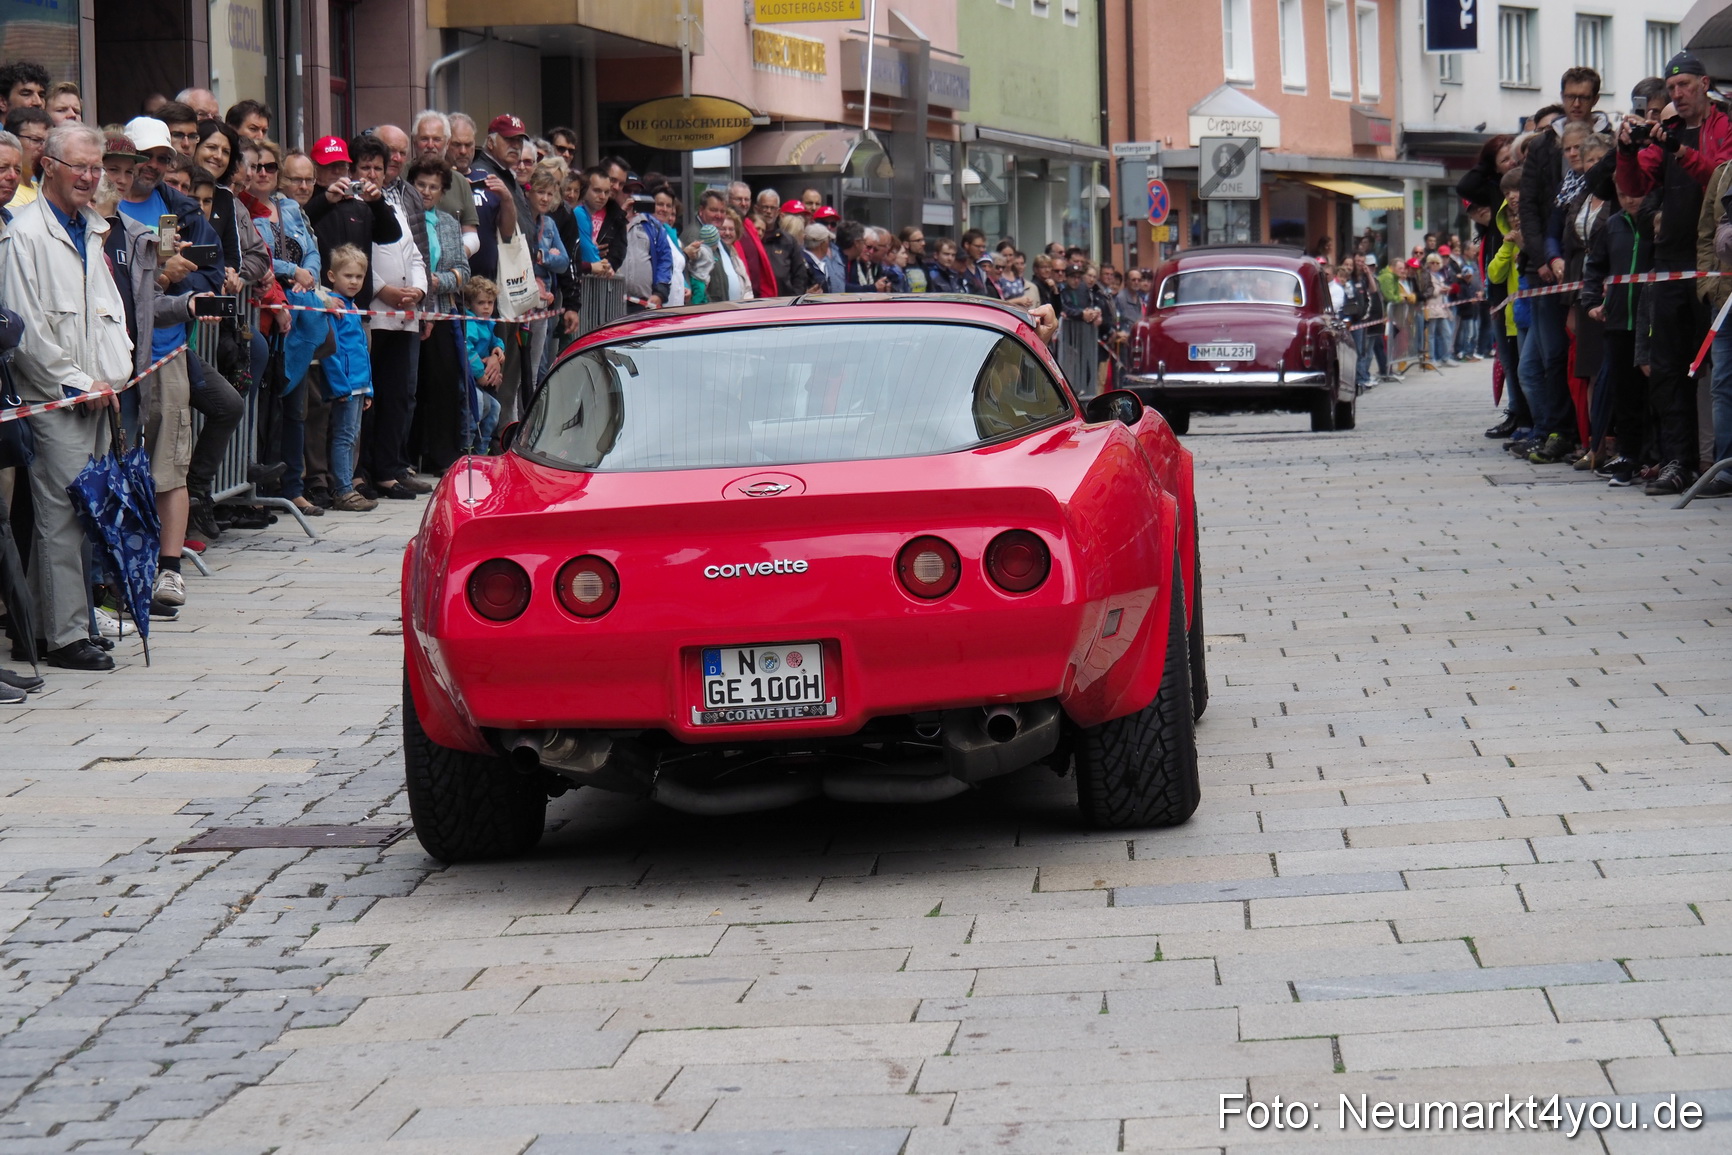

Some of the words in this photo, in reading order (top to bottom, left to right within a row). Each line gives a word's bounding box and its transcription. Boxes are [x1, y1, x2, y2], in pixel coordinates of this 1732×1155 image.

[760, 1, 844, 15] KLOSTERGASSE
[849, 0, 856, 9] 4
[228, 3, 262, 53] CECIL
[626, 119, 648, 130] DIE
[651, 117, 750, 130] GOLDSCHMIEDE
[1207, 117, 1263, 133] Creppresso
[660, 134, 682, 142] JUTTA
[684, 133, 714, 141] ROTHER
[1115, 145, 1152, 154] Klostergasse
[1215, 182, 1243, 193] ZONE
[1197, 347, 1211, 357] NM
[1216, 347, 1230, 357] AL
[1231, 347, 1252, 357] 23H
[703, 559, 809, 579] corvette
[738, 649, 756, 675] N
[710, 665, 717, 675] D
[708, 679, 744, 705] GE
[751, 674, 820, 703] 100H
[726, 706, 804, 721] CORVETTE
